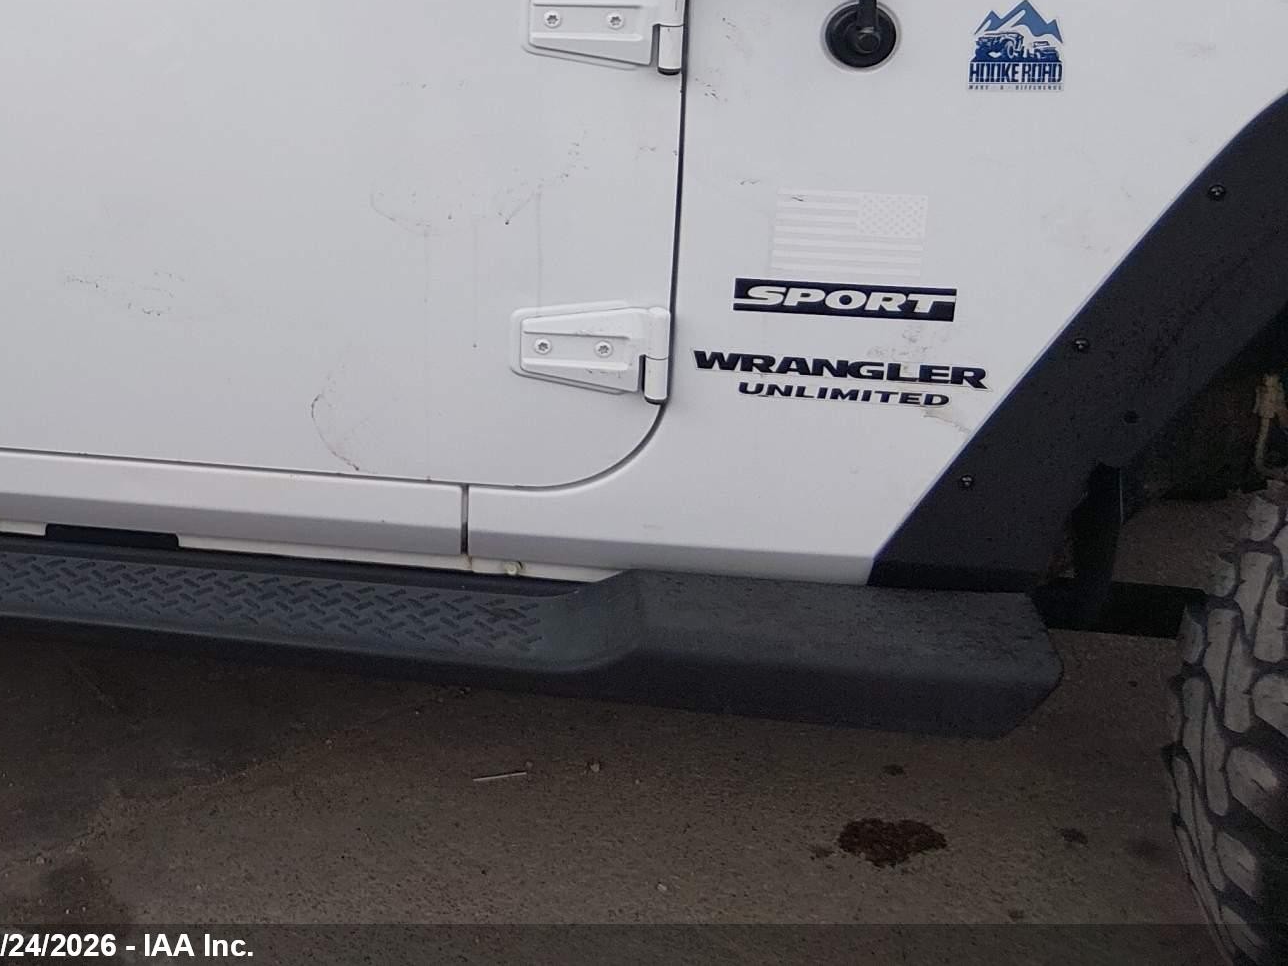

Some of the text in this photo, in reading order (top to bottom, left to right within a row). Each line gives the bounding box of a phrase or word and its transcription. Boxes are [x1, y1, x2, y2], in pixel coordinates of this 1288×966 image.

[969, 63, 1063, 82] HOOKE ROAD
[734, 285, 956, 313] SPORT
[693, 350, 988, 389] WRANGLER
[738, 382, 950, 407] UNLIMITED
